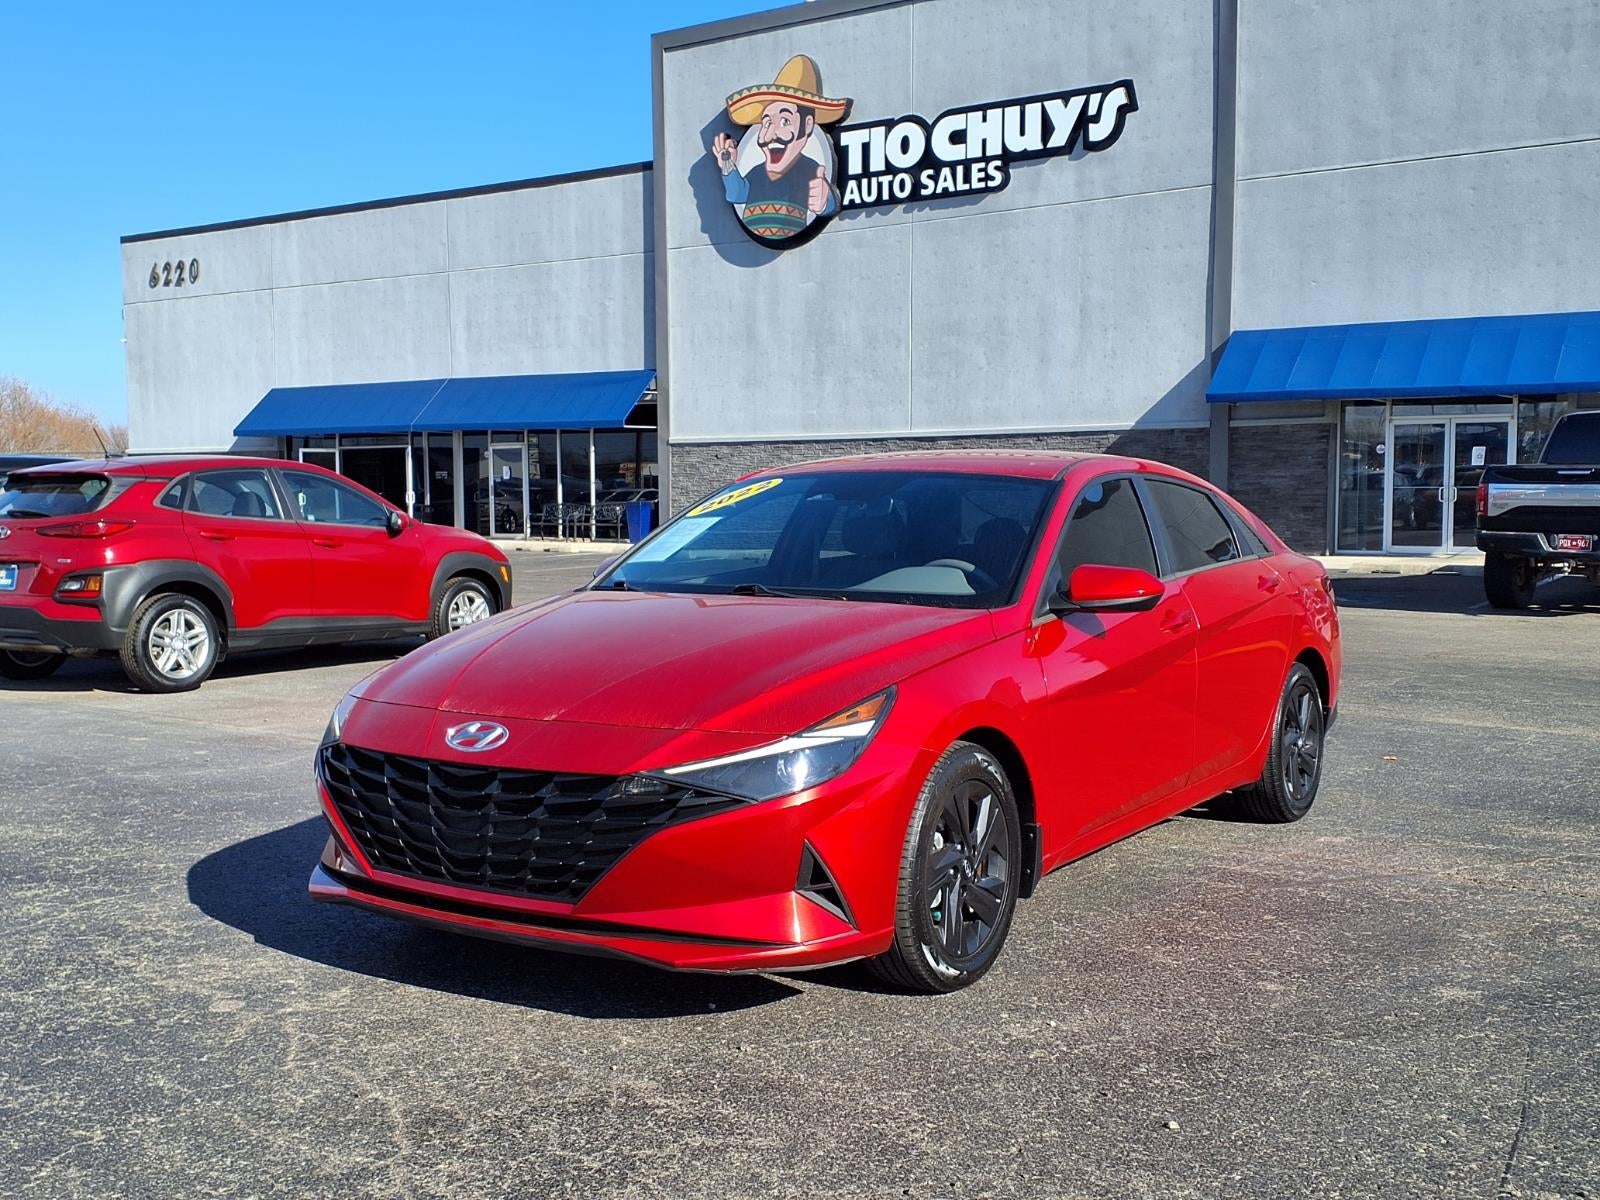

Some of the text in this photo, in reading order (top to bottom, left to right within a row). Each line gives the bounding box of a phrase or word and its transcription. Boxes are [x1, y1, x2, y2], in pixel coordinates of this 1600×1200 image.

[840, 86, 1128, 174] TIO CHUY'S
[842, 160, 1003, 205] AUTO SALES
[149, 258, 198, 289] 6220
[700, 481, 773, 511] 2022
